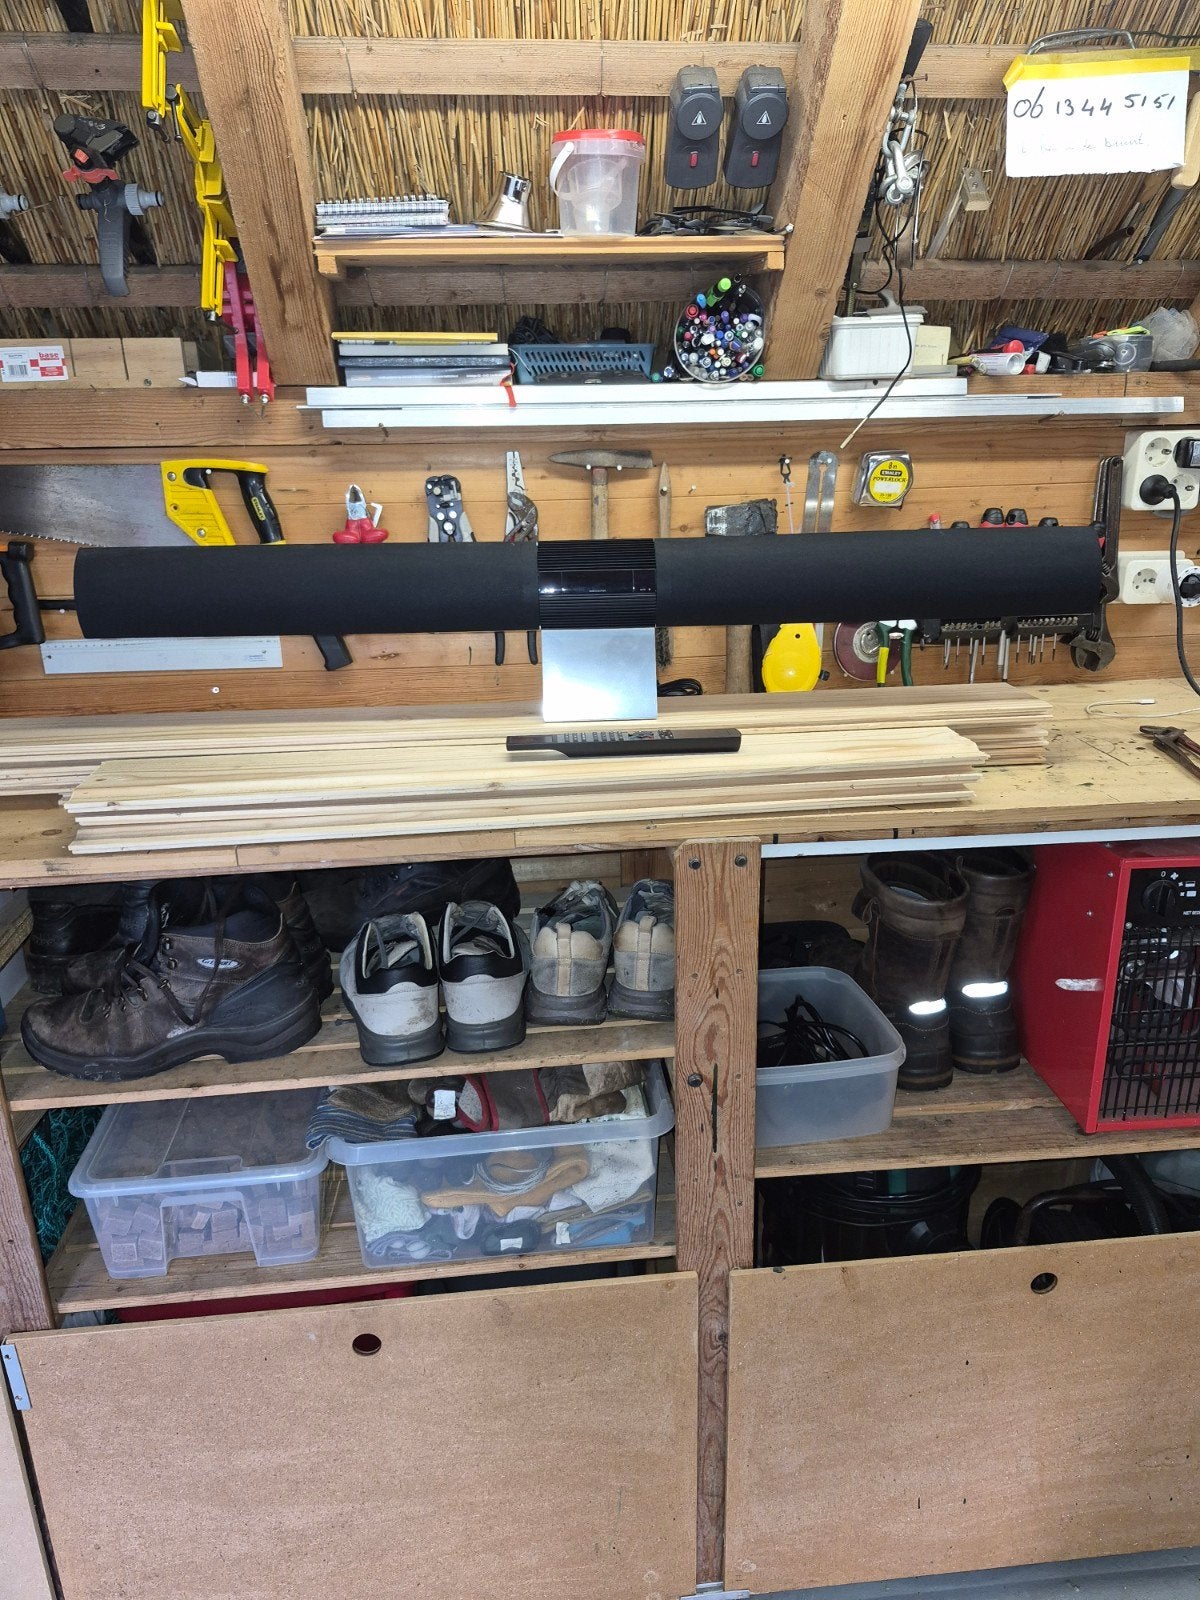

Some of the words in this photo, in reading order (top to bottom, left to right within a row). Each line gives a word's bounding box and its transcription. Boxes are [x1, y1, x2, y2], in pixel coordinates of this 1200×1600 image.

[1013, 86, 1045, 118] 06
[1056, 98, 1075, 116] 13
[1081, 98, 1112, 116] 44
